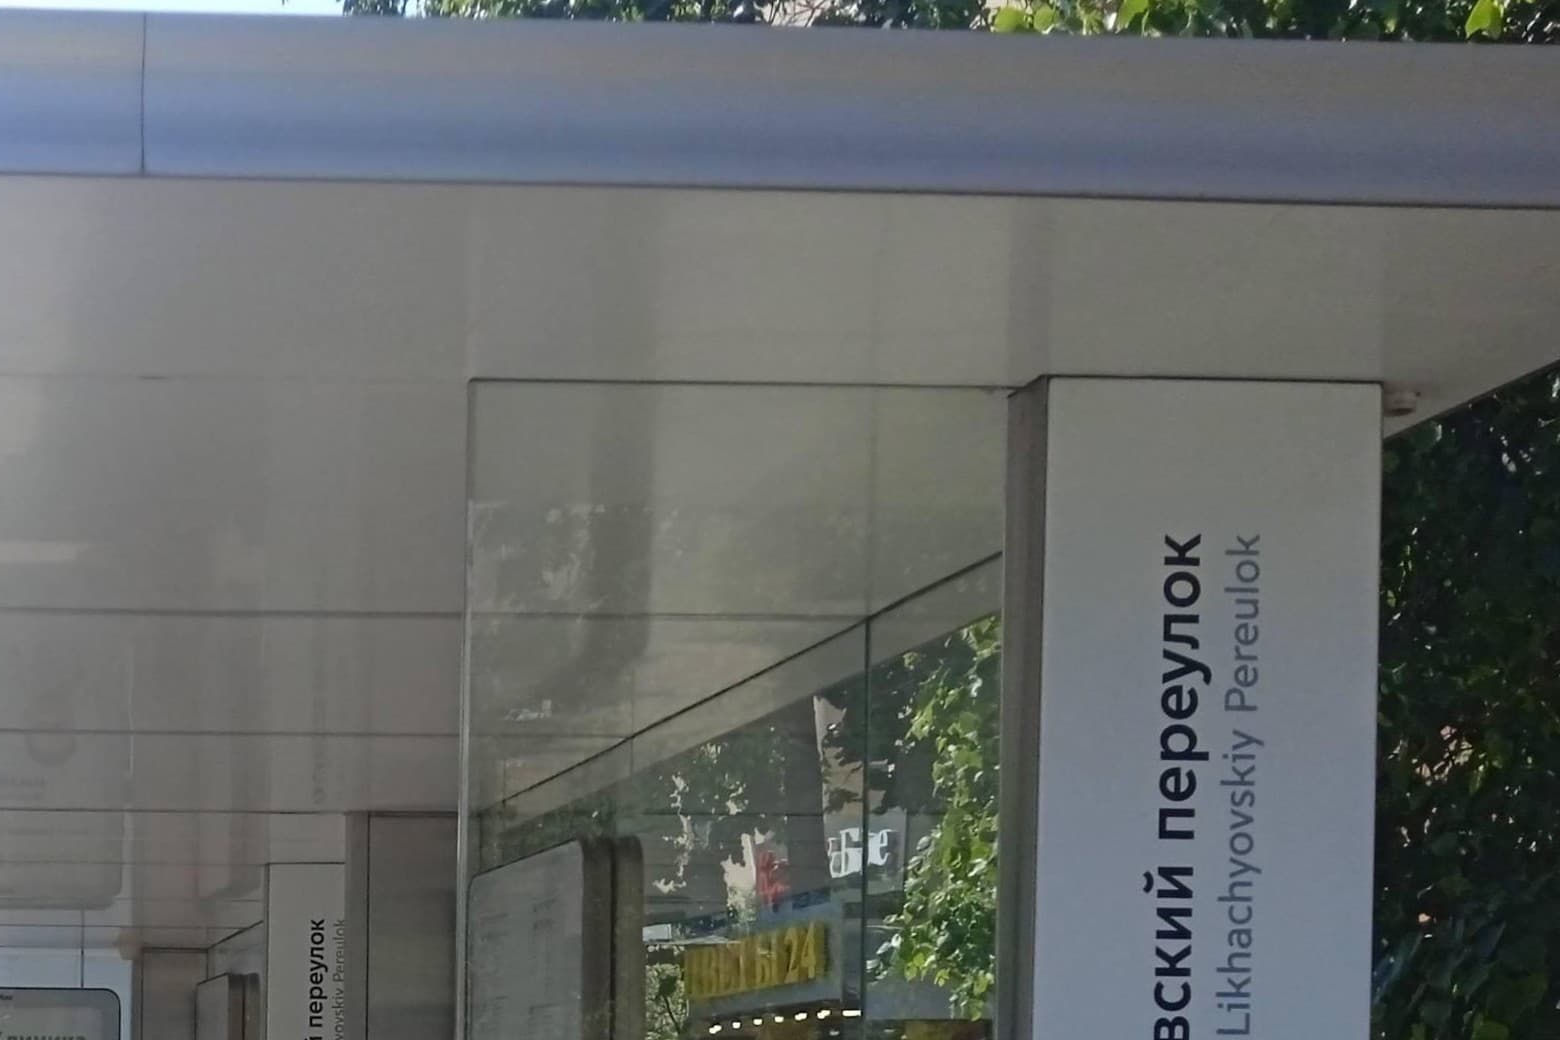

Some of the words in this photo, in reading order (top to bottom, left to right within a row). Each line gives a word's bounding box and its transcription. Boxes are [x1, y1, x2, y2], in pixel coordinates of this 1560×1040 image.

[1154, 532, 1212, 842] переулок
[1225, 532, 1261, 714] Pereulok
[308, 918, 328, 1028] переулок
[1217, 727, 1265, 1037] Likhachyovskiy
